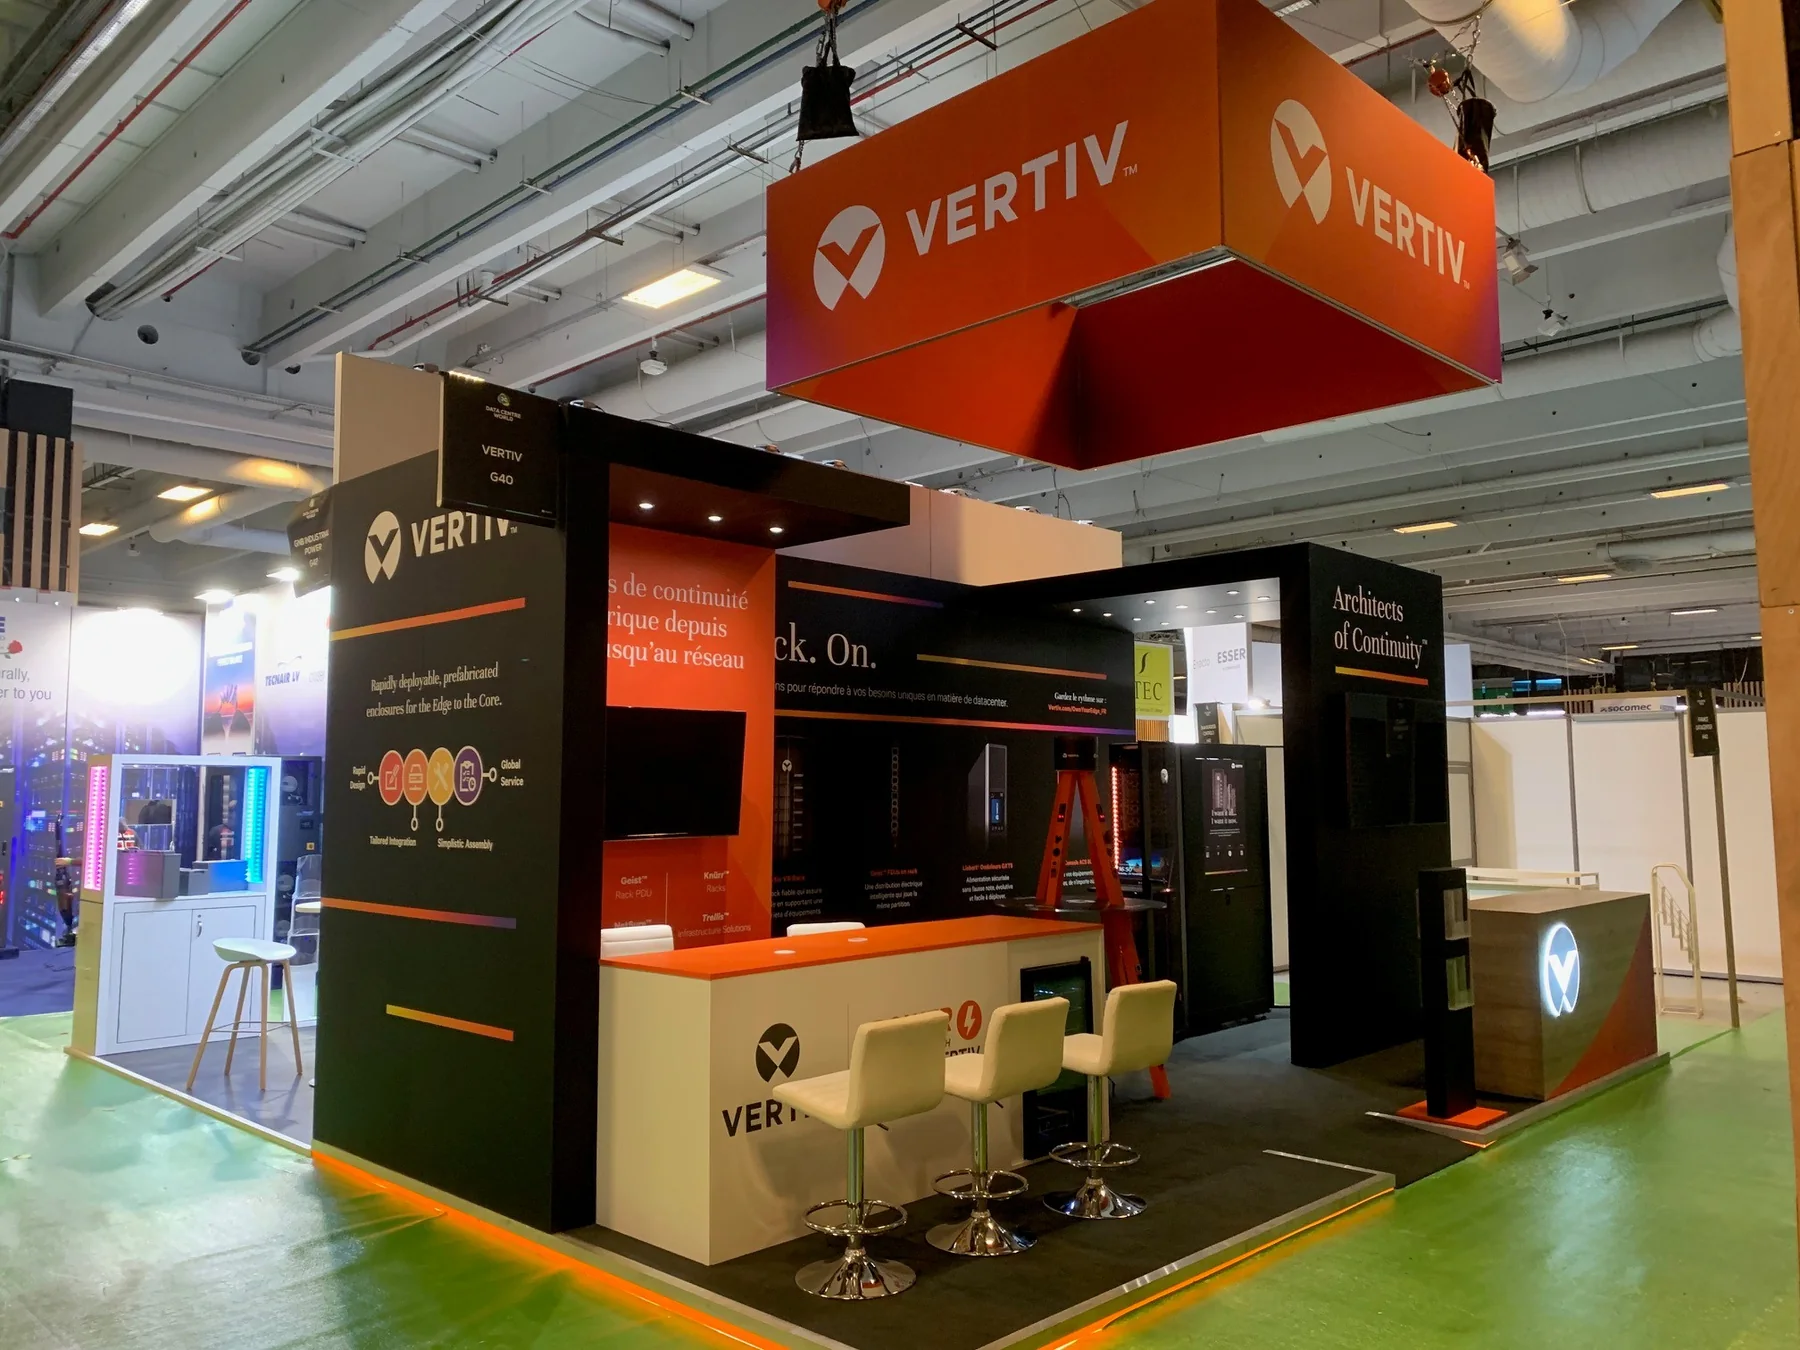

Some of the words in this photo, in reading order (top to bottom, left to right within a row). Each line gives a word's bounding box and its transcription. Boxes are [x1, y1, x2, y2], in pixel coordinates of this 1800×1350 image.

[906, 120, 1128, 256] VERTIV
[1346, 166, 1465, 285] VERTIV
[481, 444, 523, 462] VERTIV
[490, 471, 514, 485] G40
[623, 572, 647, 598] de
[653, 584, 748, 610] continuité
[1333, 584, 1404, 622] Architects
[665, 609, 728, 641] depuis
[1334, 620, 1351, 650] of
[683, 645, 745, 670] réseau
[827, 633, 877, 669] On.
[1217, 647, 1246, 664] ESSER
[0, 668, 30, 683] rally,
[371, 674, 397, 695] Rapidly
[398, 669, 442, 692] deployable,
[443, 661, 499, 688] prefabricated
[13, 687, 26, 699] to
[29, 690, 52, 702] you
[787, 683, 807, 694] pour
[808, 683, 845, 697] répondre
[846, 685, 852, 696] à
[853, 688, 867, 697] vos
[868, 687, 897, 699] besoins
[897, 691, 926, 703] uniques
[926, 693, 936, 702] en
[937, 693, 963, 704] matière
[963, 695, 973, 705] de
[366, 702, 404, 717] enclosures
[405, 699, 417, 714] for
[419, 698, 431, 712] the
[433, 695, 452, 715] Edge
[454, 698, 461, 710] to
[463, 693, 478, 709] the
[479, 694, 502, 708] Core.
[1607, 704, 1652, 712] socomec
[501, 759, 521, 771] Global
[501, 776, 524, 787] Service
[437, 838, 464, 850] Simplistic
[465, 839, 493, 852] Assembly
[615, 889, 633, 899] Rack
[635, 888, 652, 898] PDU
[706, 884, 726, 893] Racks
[677, 927, 722, 938] Infrastructure
[722, 924, 751, 934] Solutions
